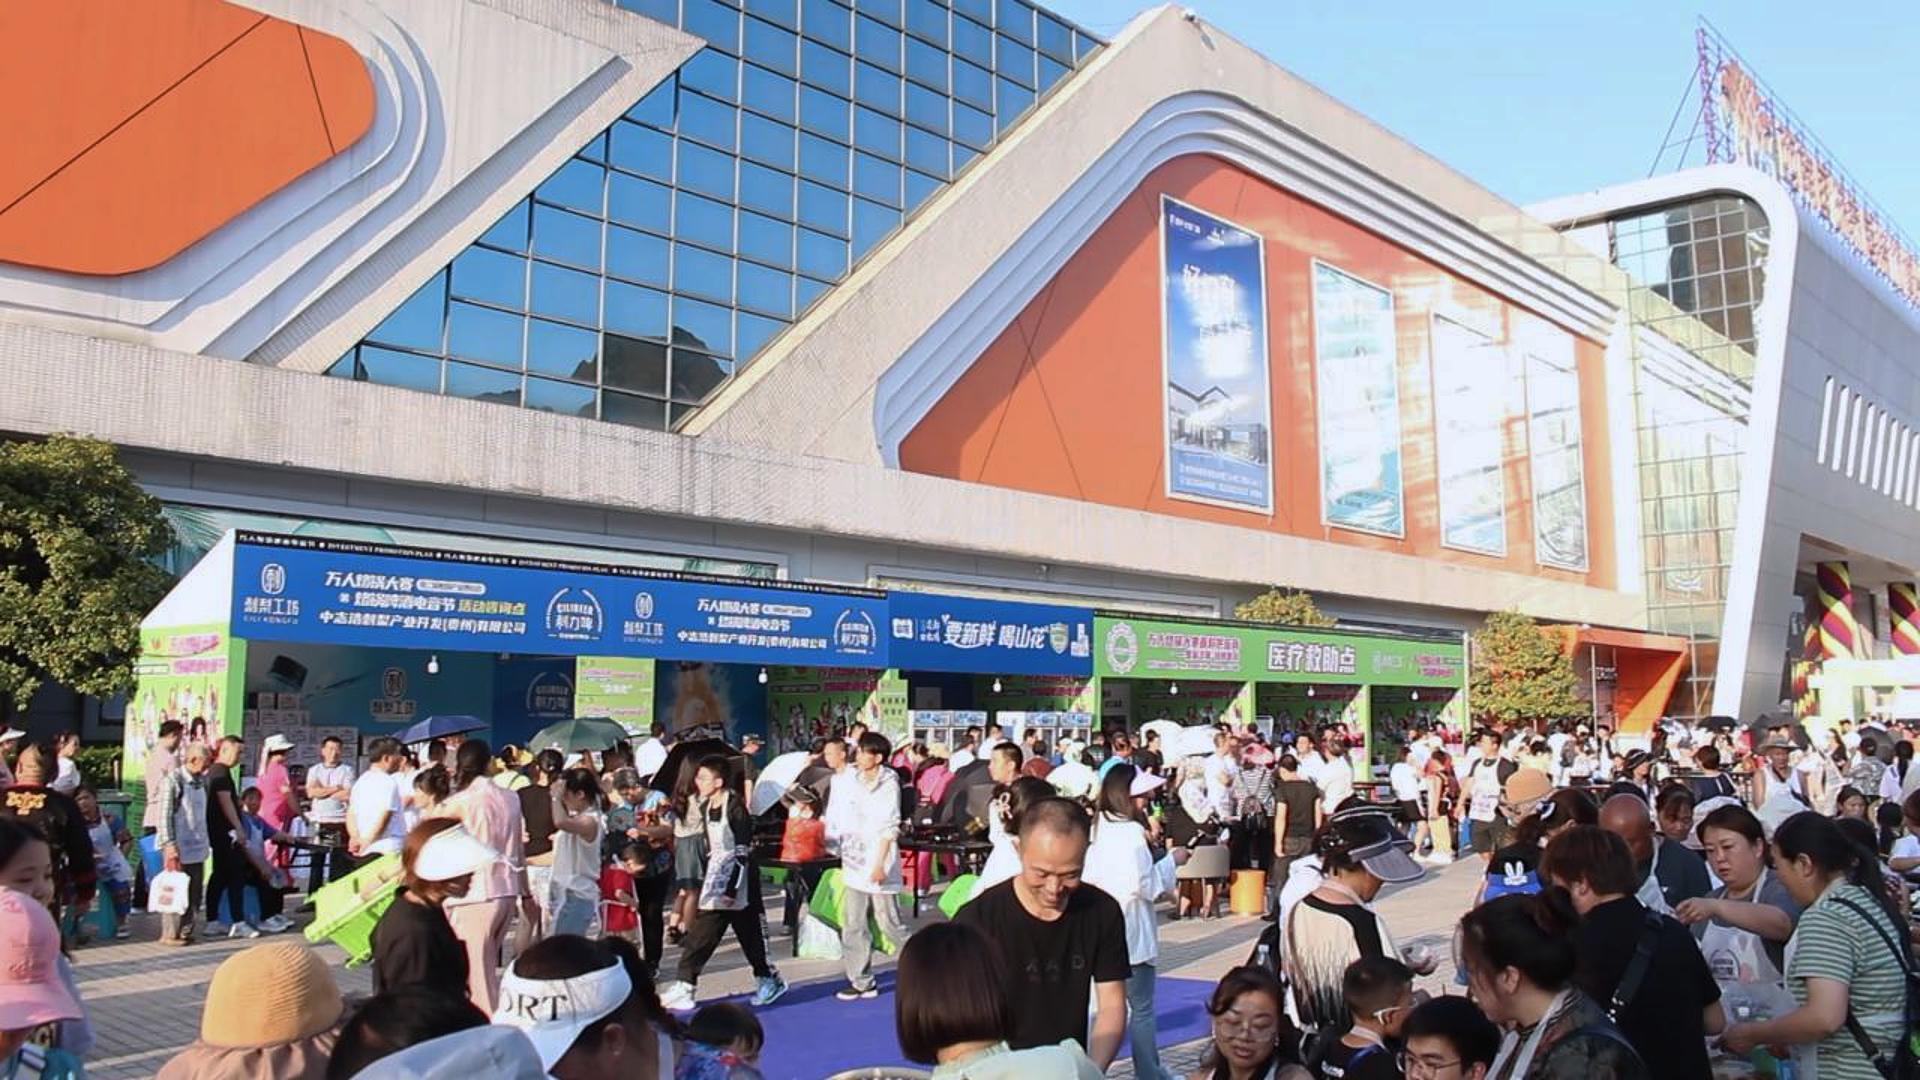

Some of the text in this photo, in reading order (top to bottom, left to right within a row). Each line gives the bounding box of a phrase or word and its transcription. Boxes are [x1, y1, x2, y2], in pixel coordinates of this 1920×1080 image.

[1267, 641, 1356, 674] 医疗救助点
